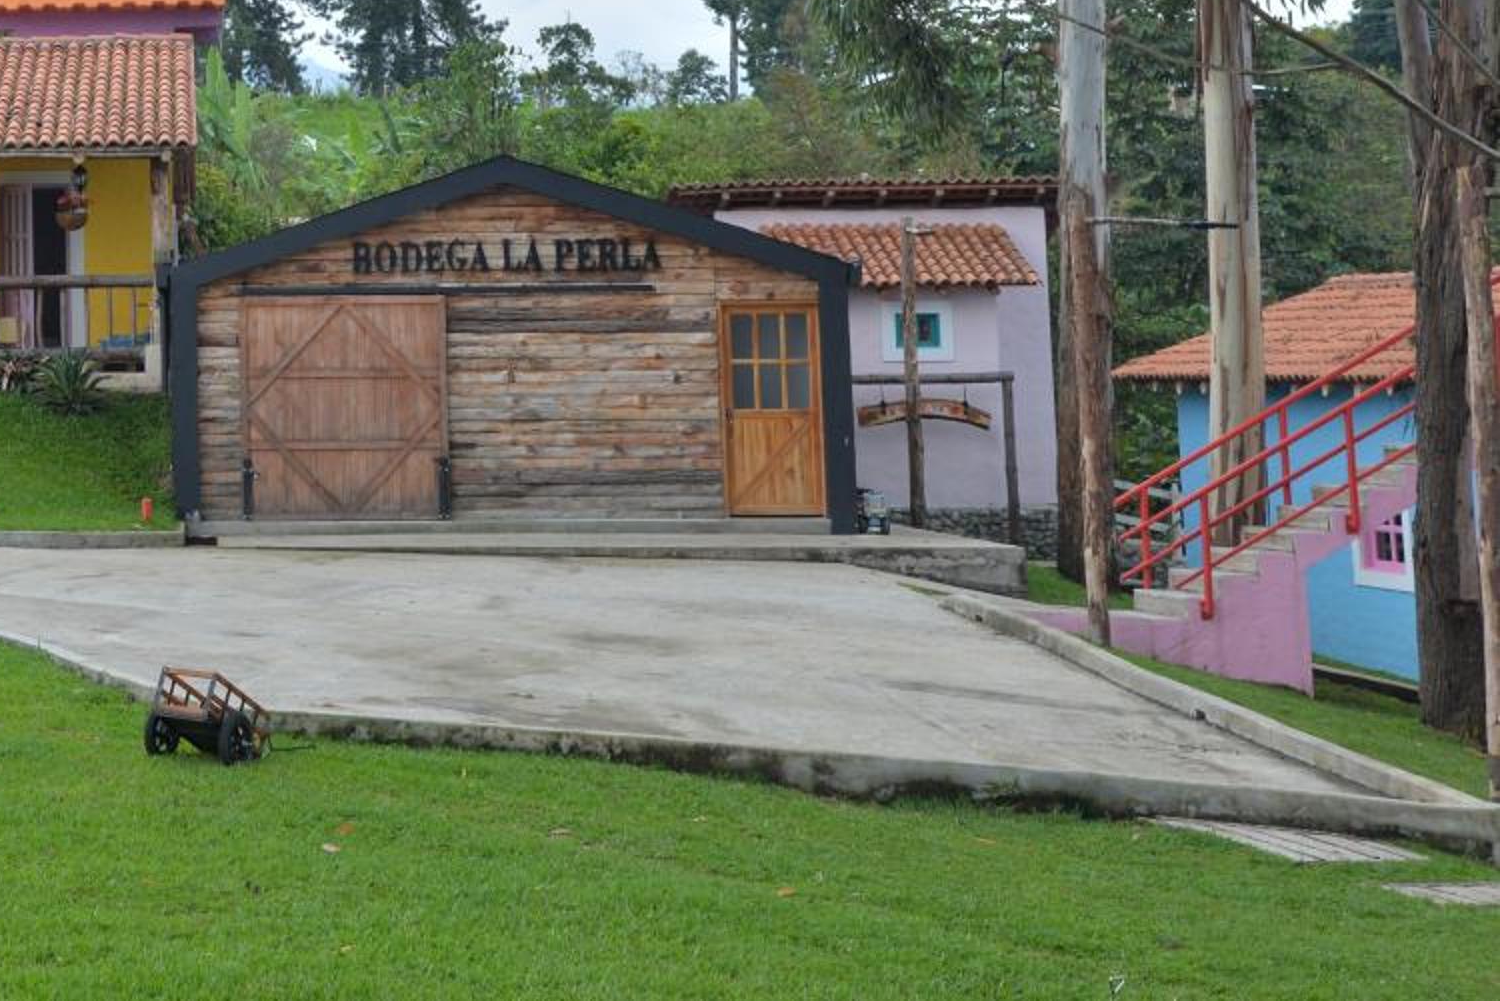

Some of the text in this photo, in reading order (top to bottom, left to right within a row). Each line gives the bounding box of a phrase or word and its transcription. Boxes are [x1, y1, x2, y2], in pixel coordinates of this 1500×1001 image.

[353, 238, 662, 273] BODEGA LA PERLA
